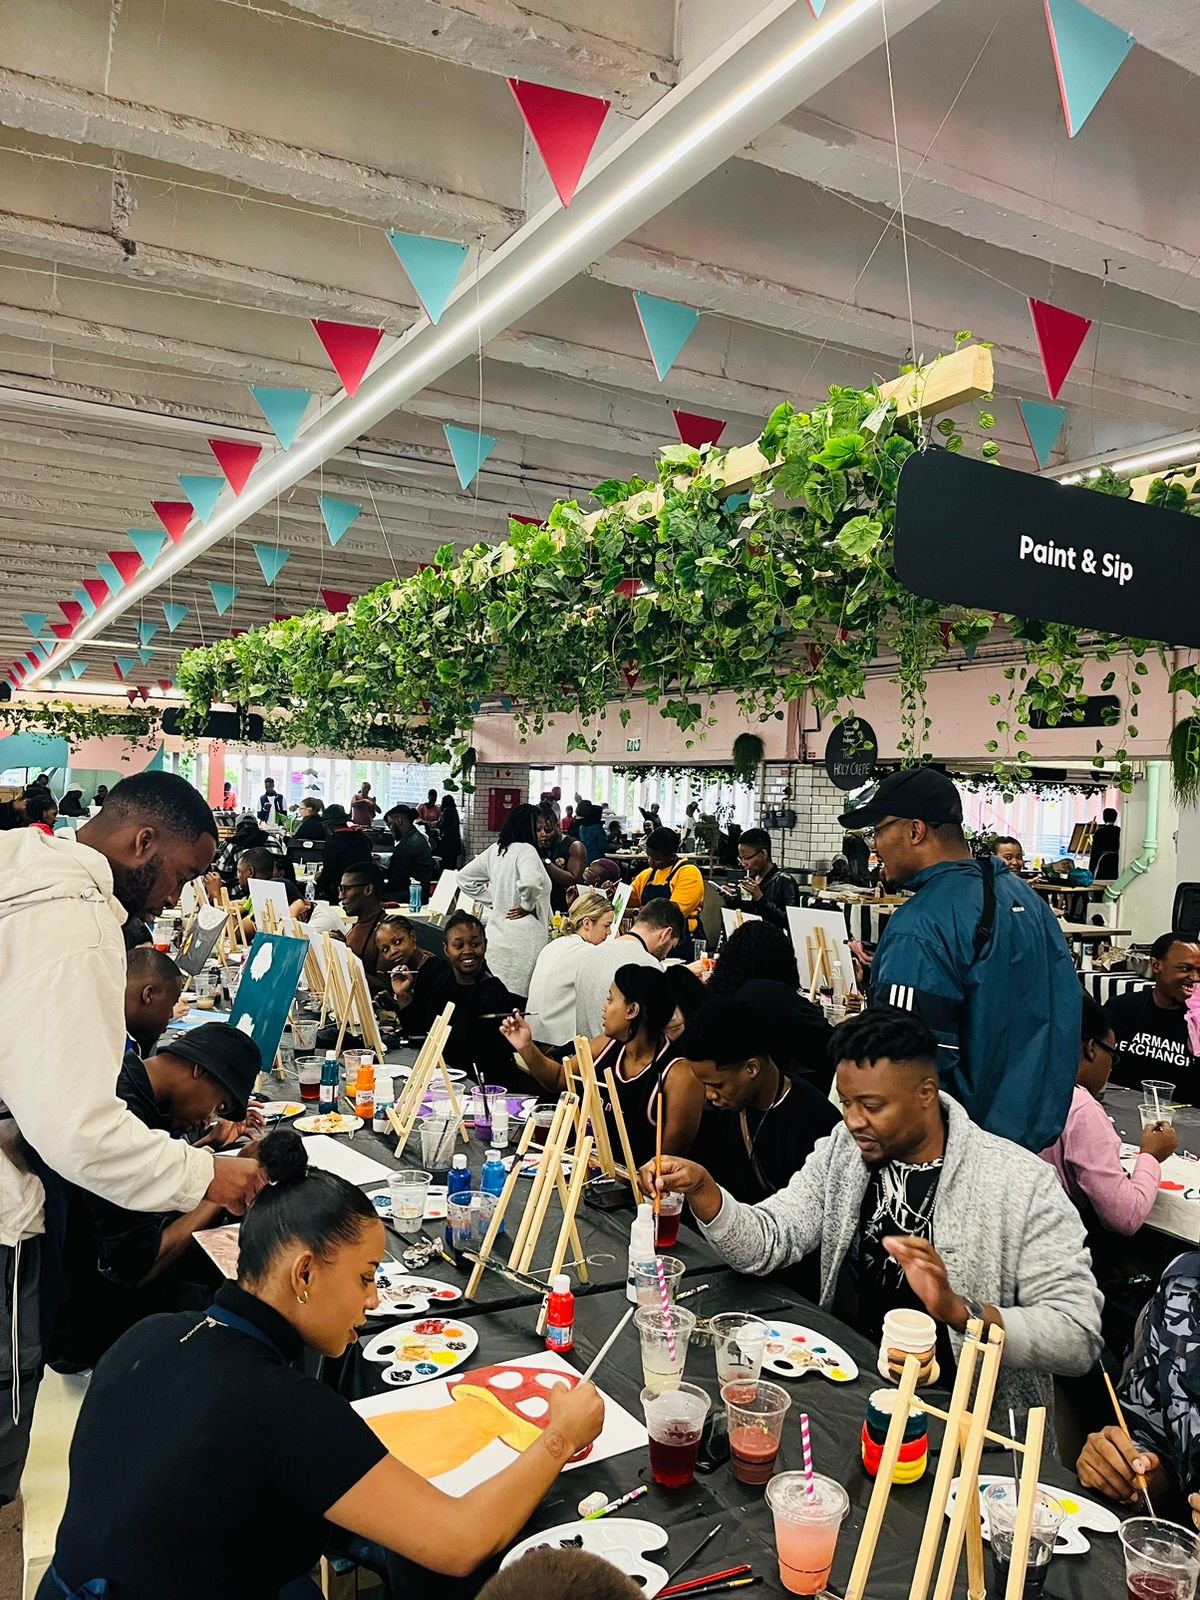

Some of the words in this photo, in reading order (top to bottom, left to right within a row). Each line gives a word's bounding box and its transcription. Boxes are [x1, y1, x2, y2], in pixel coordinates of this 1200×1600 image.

[1020, 535, 1077, 570] Paint
[1081, 548, 1097, 574] &
[1101, 553, 1133, 586] Sip
[1132, 1032, 1185, 1055] ARMANI
